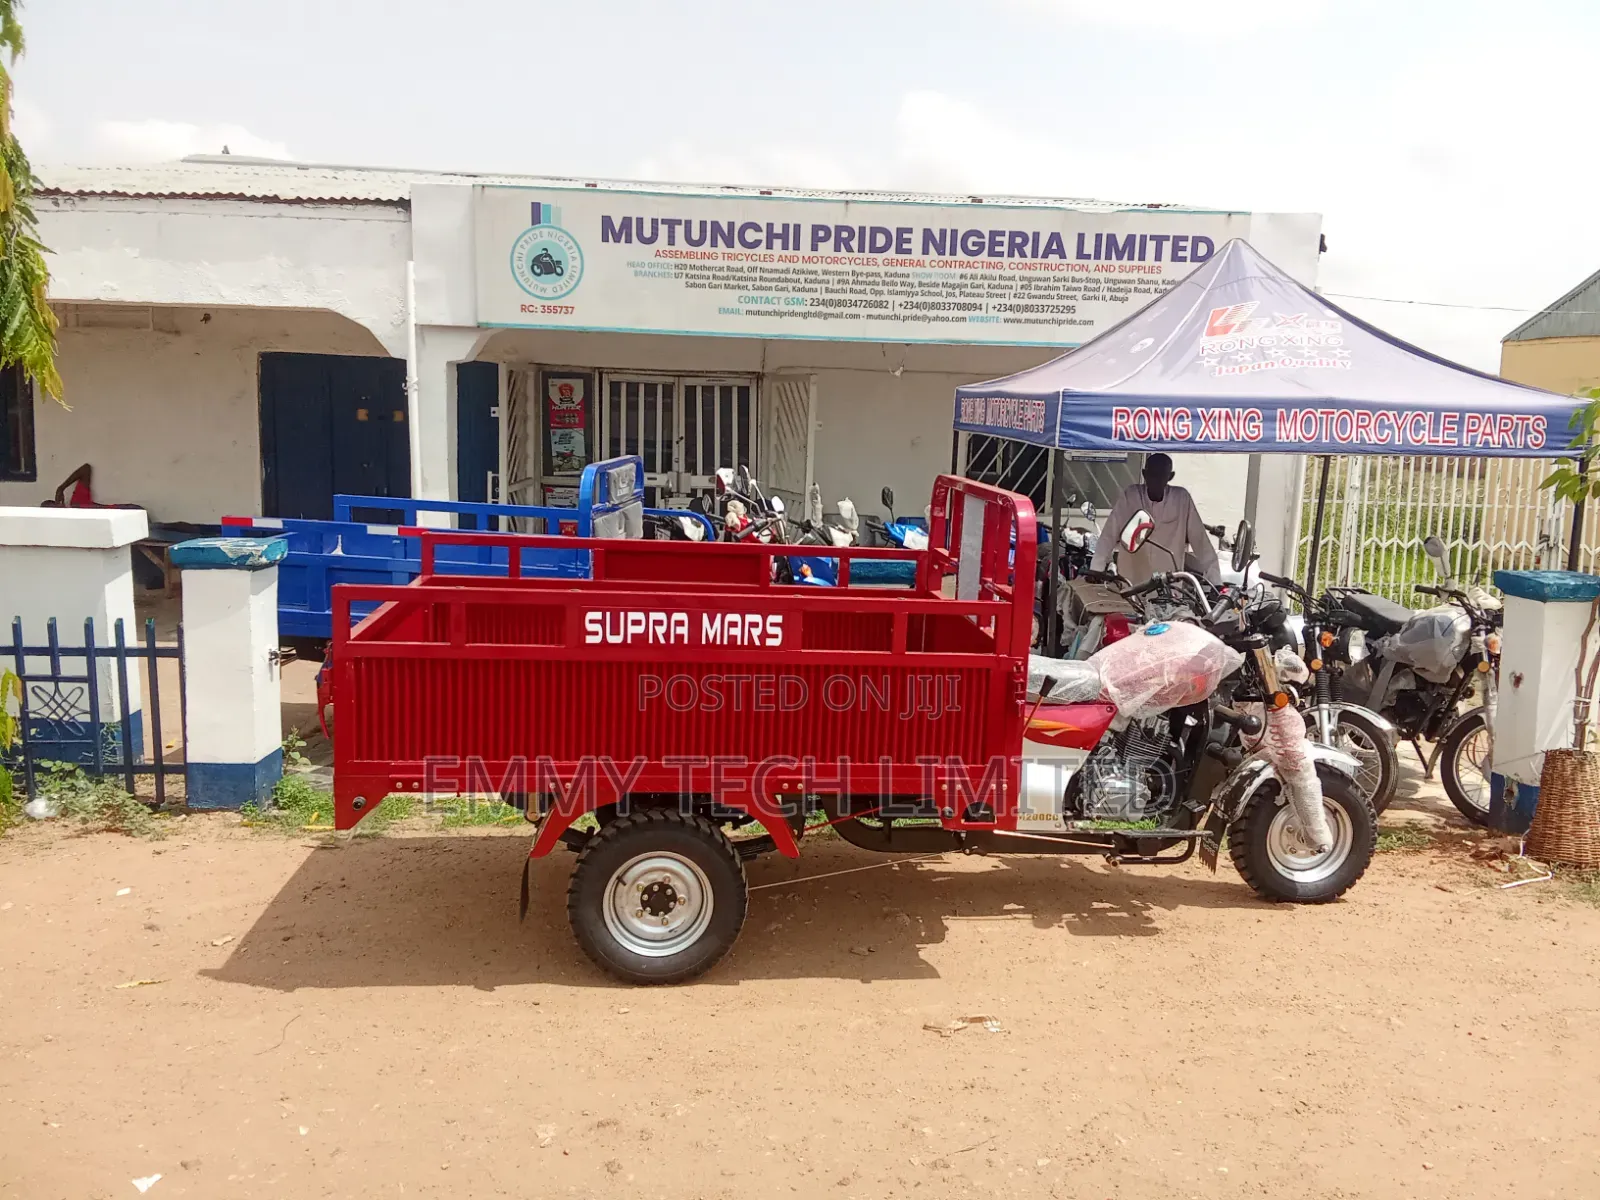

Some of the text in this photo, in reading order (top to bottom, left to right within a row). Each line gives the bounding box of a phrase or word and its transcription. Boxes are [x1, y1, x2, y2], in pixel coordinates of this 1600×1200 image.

[520, 231, 544, 250] PRIDE
[548, 231, 577, 261] NIGERIA
[601, 215, 1215, 263] MUTUNCHI PRIDE NIGERIA LIMITED
[654, 249, 1162, 274] ASSEMBLING TRICYCLES AND MOTORCYCLES, GENERAL CONTRACTING, CONSTRUCTION, AND SUPPLIES
[685, 281, 707, 289] Sabon
[708, 282, 723, 290] Gari
[724, 283, 750, 292] Market,
[752, 284, 772, 292] Sabon
[774, 284, 791, 293] Gari,
[849, 288, 868, 296] Road,
[870, 288, 885, 297] Opp.
[920, 290, 944, 298] School,
[960, 291, 984, 299] Plateau
[1056, 294, 1078, 302] Street,
[1109, 295, 1129, 303] Abuja
[520, 304, 575, 315] RC: 355737
[738, 295, 782, 305] CONTACT
[783, 297, 808, 306] GSM:
[809, 298, 889, 310] 234(0)8034726082
[898, 301, 983, 312] +234(0)8033708094
[992, 303, 1076, 314] +234(0)8033725295
[718, 307, 744, 316] EMAIL:
[745, 309, 860, 320] mutunchipridengltd@gmail.com
[866, 313, 966, 325] mutunchi.pride@yahoo.com
[968, 315, 1001, 323] WEBSITE:
[1004, 317, 1094, 327] www.mutunchipride.com
[1200, 334, 1343, 355] RONG XING
[1214, 357, 1350, 376] Japan Quality
[1112, 406, 1548, 449] RONG XING MOTORCYCLE PARTS
[584, 611, 783, 647] SUPRA MARS
